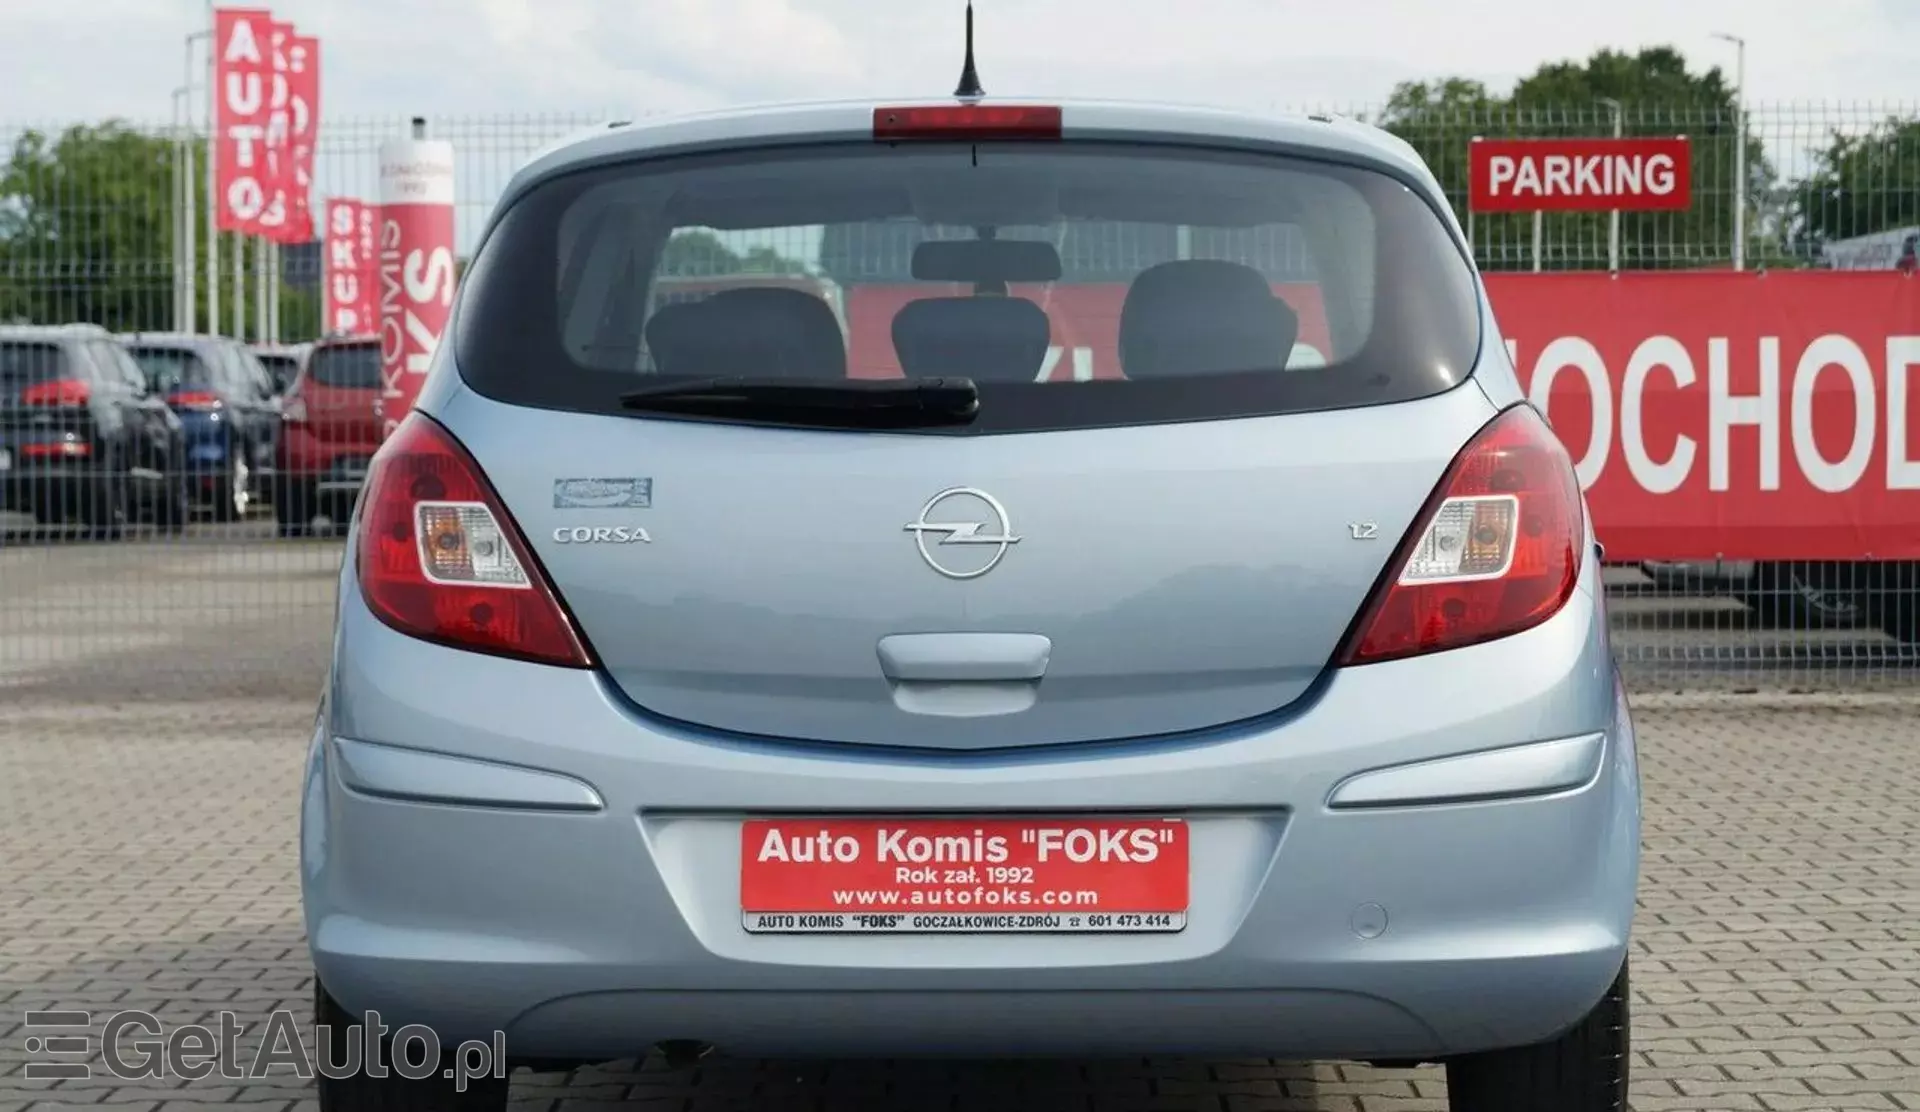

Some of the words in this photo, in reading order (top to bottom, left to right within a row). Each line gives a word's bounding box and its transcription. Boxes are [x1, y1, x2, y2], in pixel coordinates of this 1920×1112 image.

[224, 19, 264, 221] AUTO
[1489, 154, 1675, 196] PARKING
[1504, 334, 1920, 494] OCHO
[553, 526, 652, 544] CORSA
[757, 828, 860, 863] Auto
[877, 828, 1009, 863] Komis
[1021, 828, 1173, 863] "FOKS"
[896, 866, 939, 883] Rok
[944, 866, 981, 883] zał.
[987, 867, 1034, 883] 1992
[833, 886, 1098, 905] www.autofoks.com
[758, 915, 795, 928] AUTO
[799, 915, 844, 928] KOMIS
[913, 912, 1060, 928] GOCZAŁKOWICE-ZDRÓJ
[1088, 915, 1112, 927] 601
[1117, 915, 1141, 927] 473
[1145, 915, 1170, 927] 414
